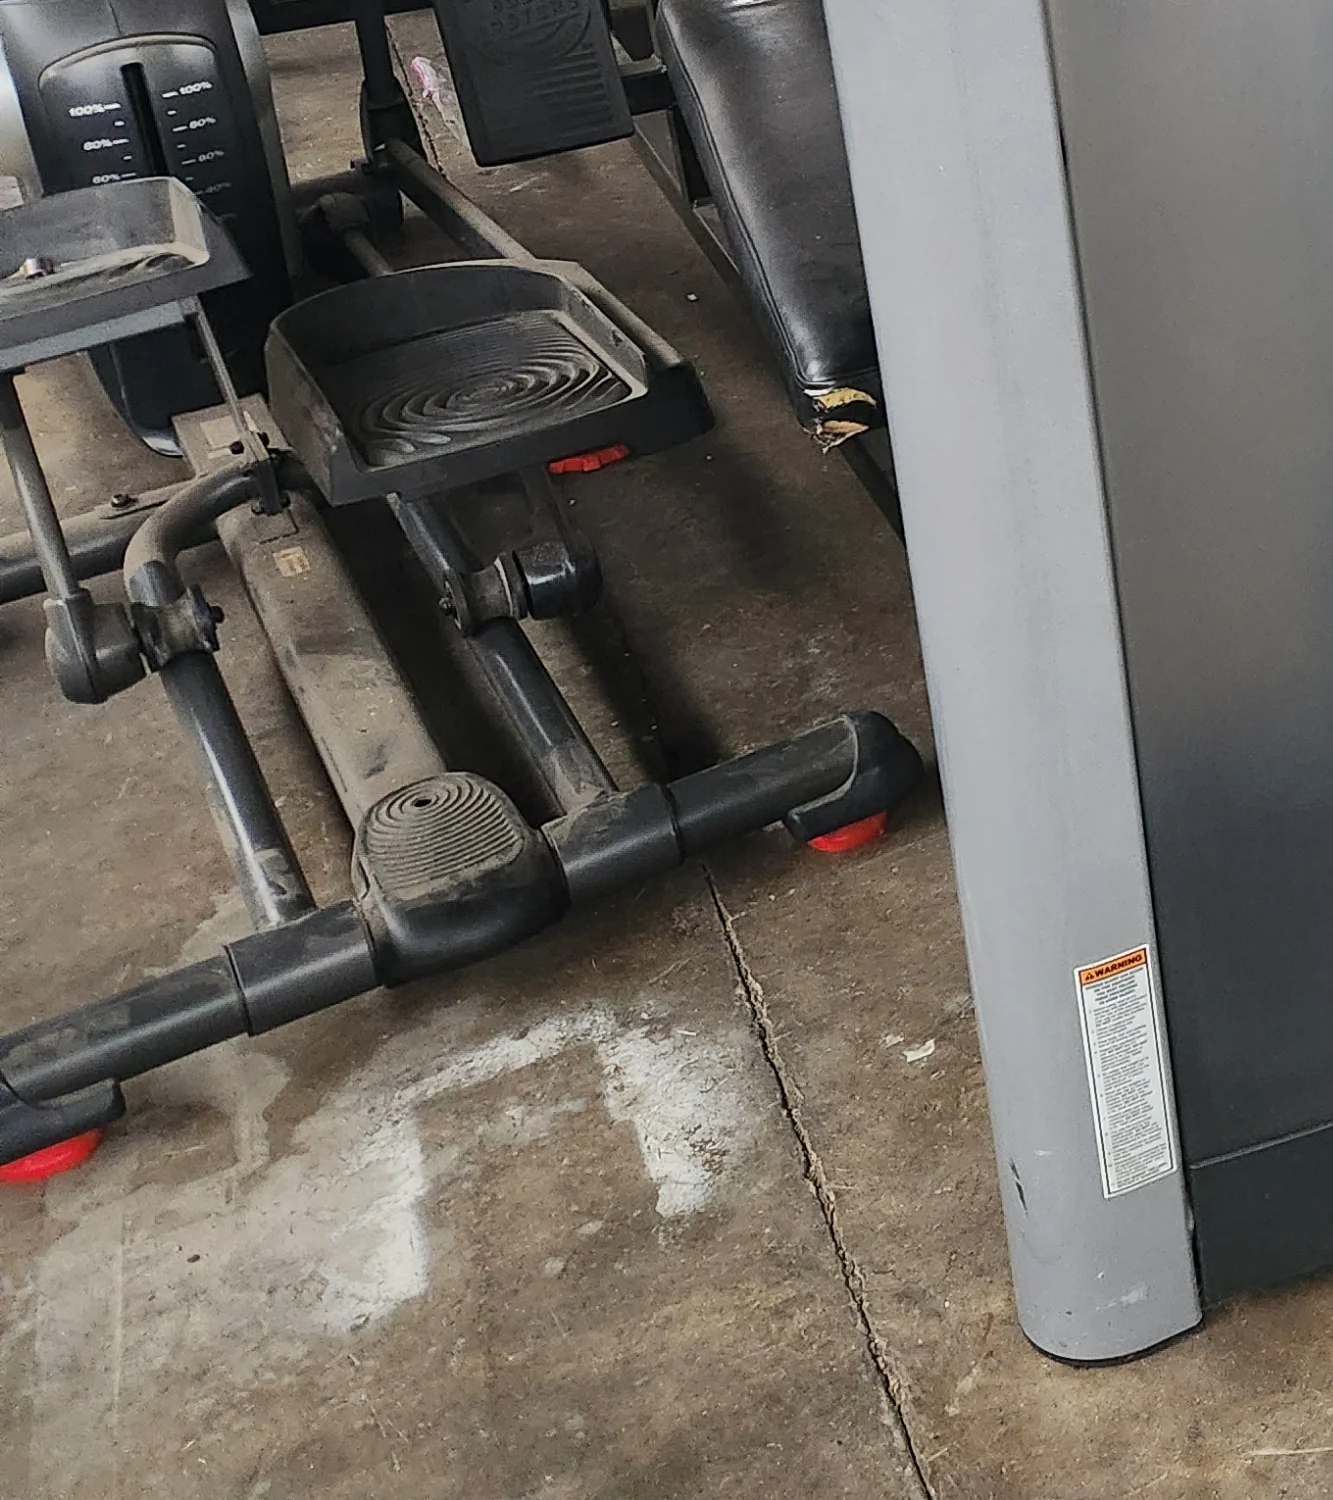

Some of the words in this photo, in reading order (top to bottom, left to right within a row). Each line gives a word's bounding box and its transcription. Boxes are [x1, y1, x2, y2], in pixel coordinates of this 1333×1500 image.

[179, 81, 213, 96] 100%
[69, 102, 105, 117] 100%
[189, 116, 217, 130] 80%
[83, 138, 113, 151] 80%
[92, 174, 121, 185] 60%
[1094, 954, 1143, 978] WARNING
